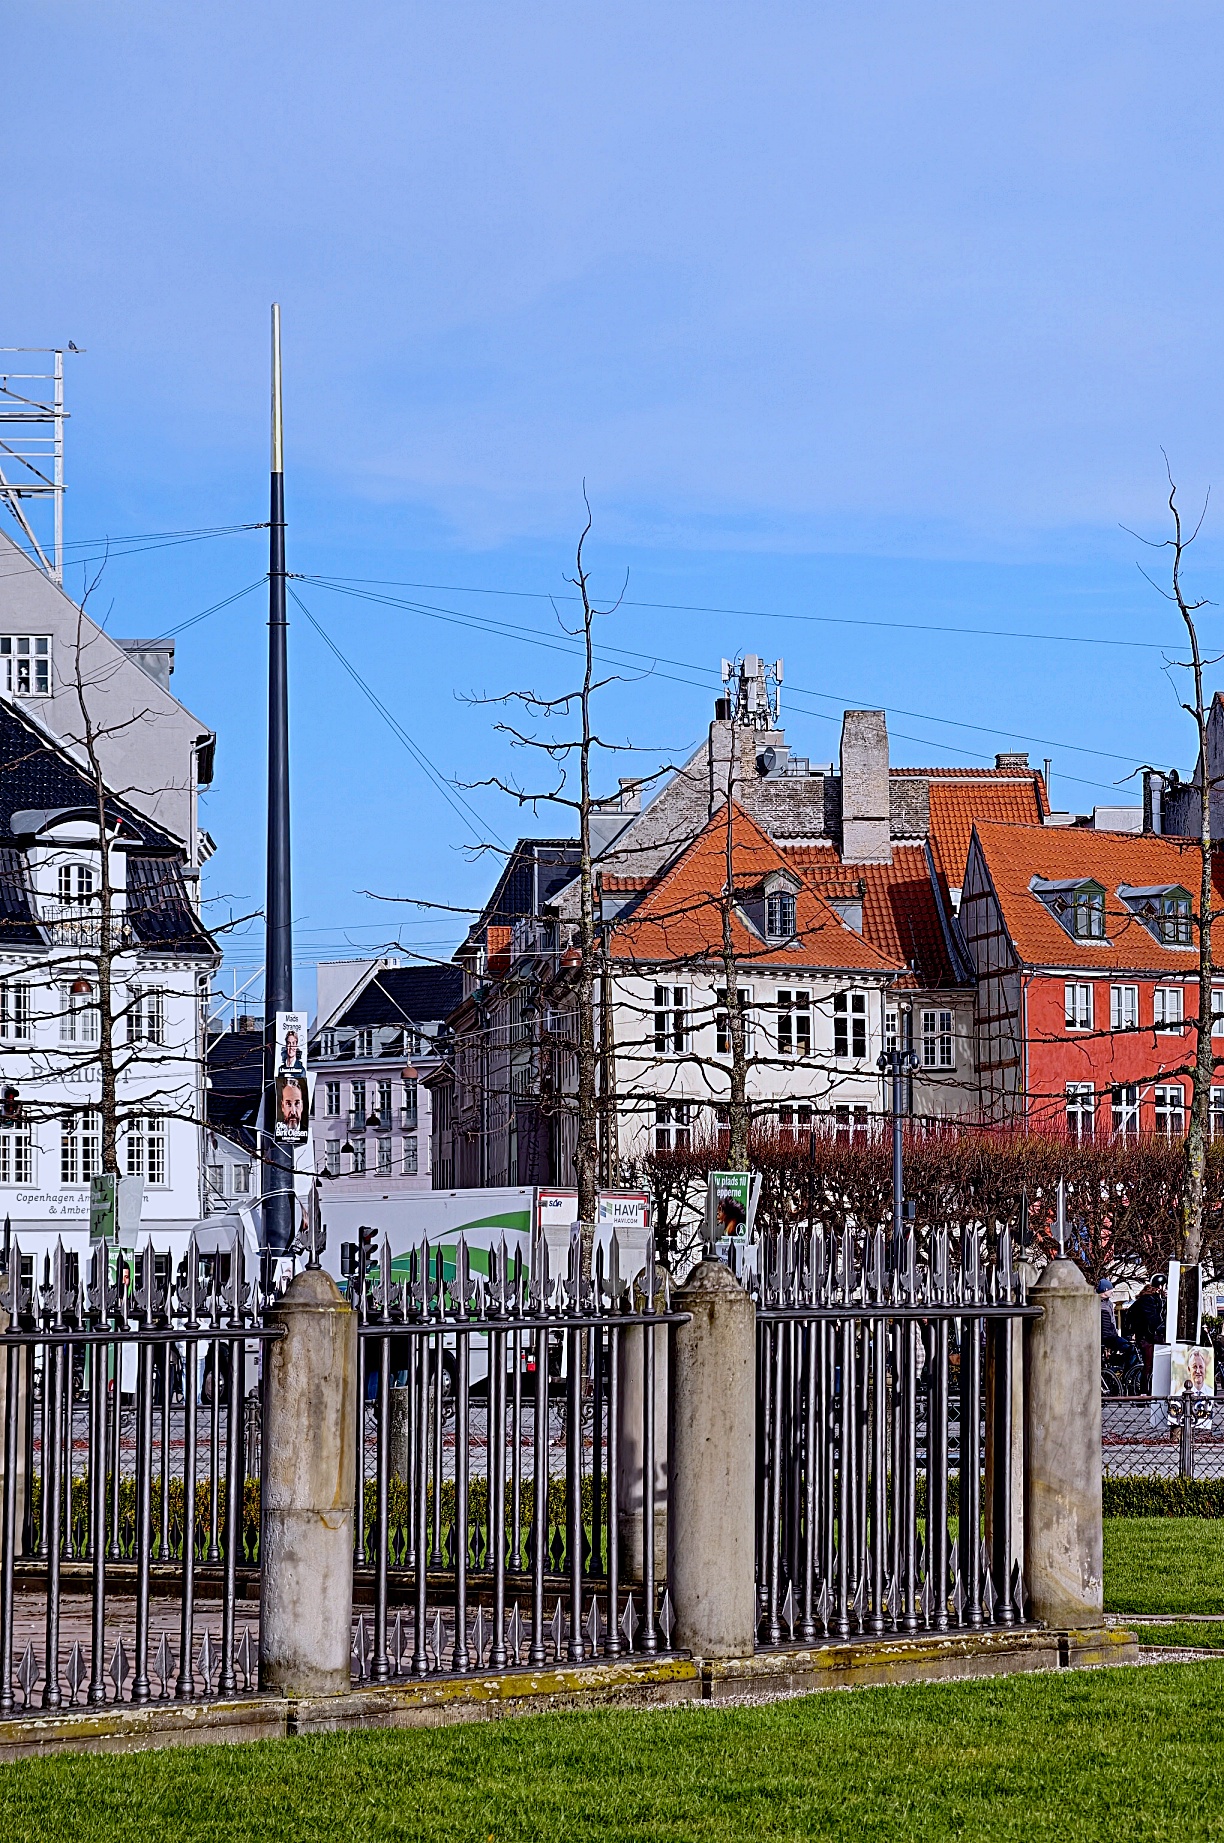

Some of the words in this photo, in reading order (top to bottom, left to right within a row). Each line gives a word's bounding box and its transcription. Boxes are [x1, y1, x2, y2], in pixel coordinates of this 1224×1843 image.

[282, 1023, 302, 1032] Strange
[721, 1176, 738, 1187] plads
[739, 1176, 747, 1186] til
[16, 1193, 74, 1205] Copenhagen
[49, 1206, 57, 1214] &
[60, 1206, 90, 1214] Amber
[614, 1204, 638, 1216] HAVI
